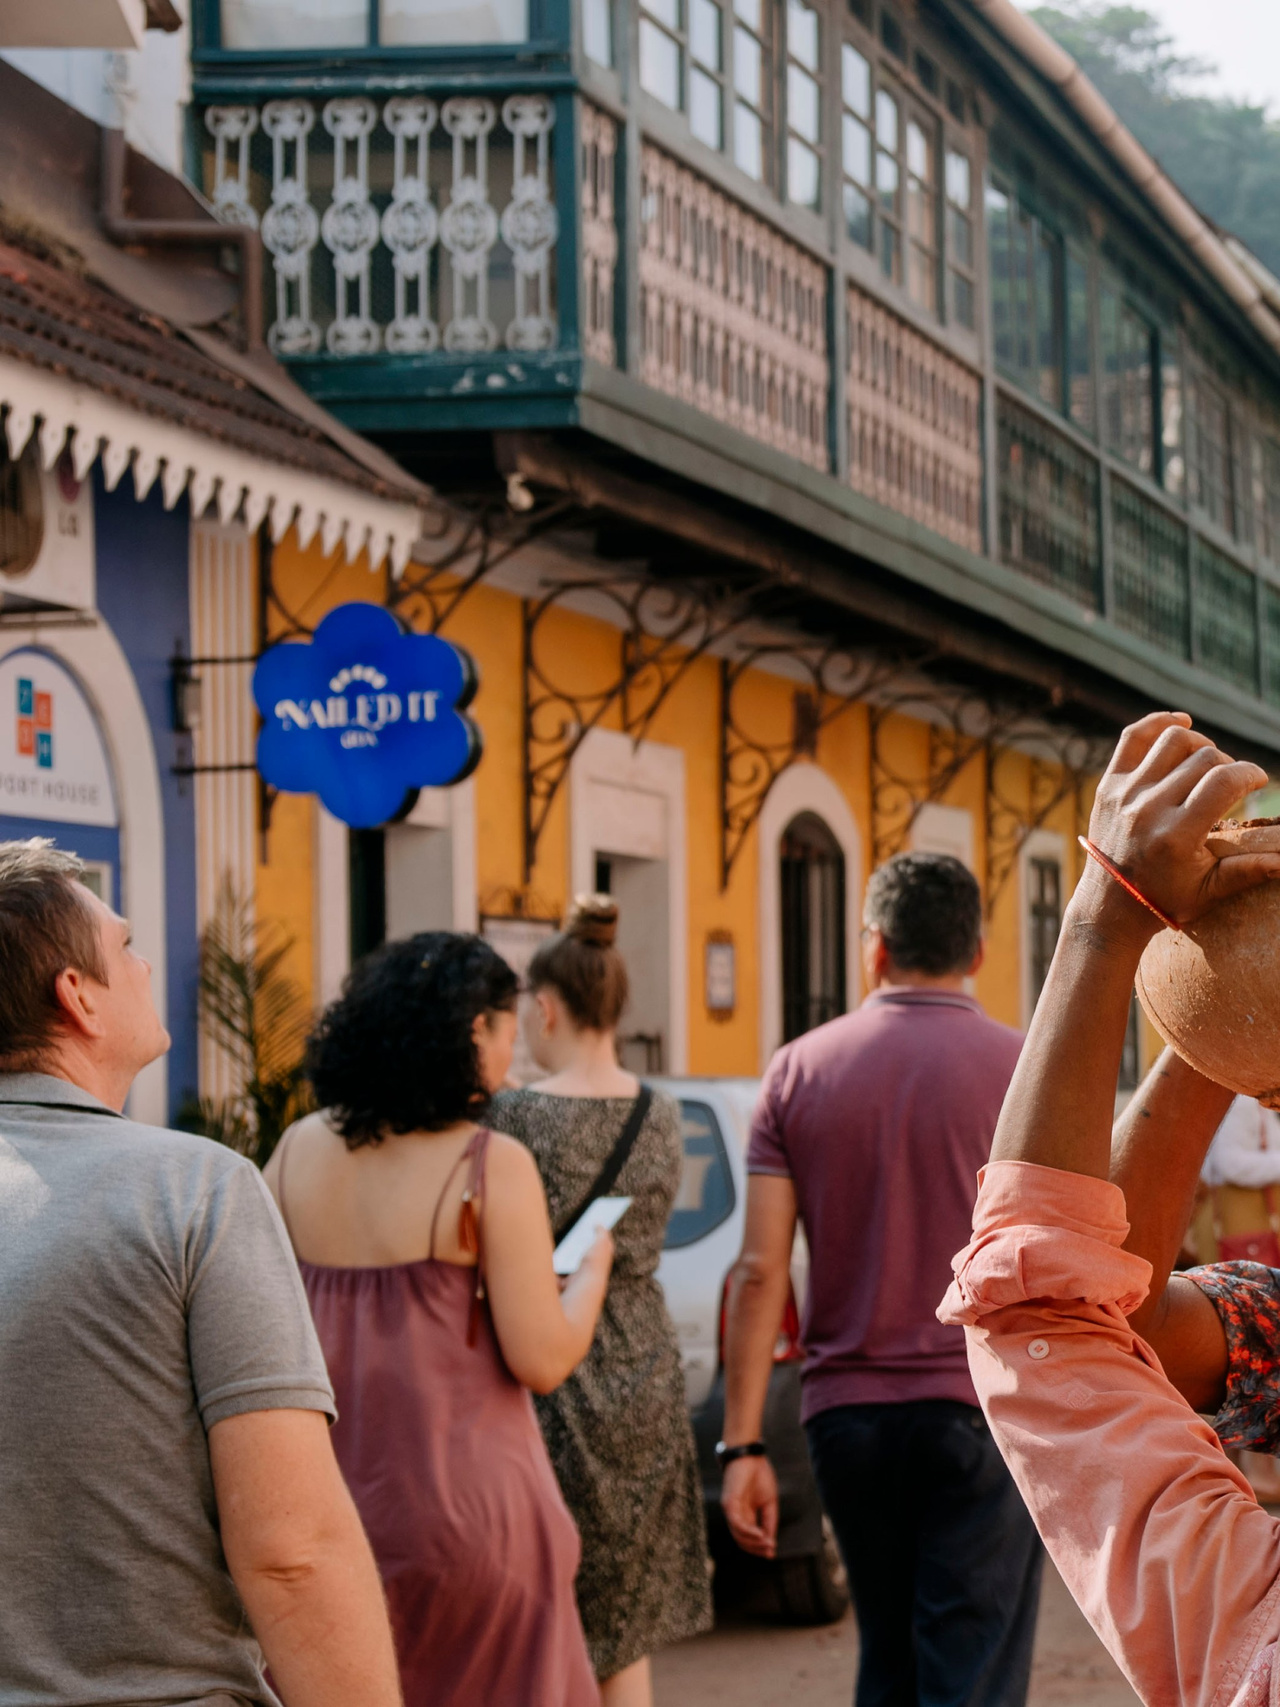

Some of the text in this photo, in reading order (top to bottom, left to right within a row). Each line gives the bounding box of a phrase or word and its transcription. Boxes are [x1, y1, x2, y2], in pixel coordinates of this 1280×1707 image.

[274, 690, 442, 732] NAILED IT
[0, 772, 100, 807] ORT HOUSE
